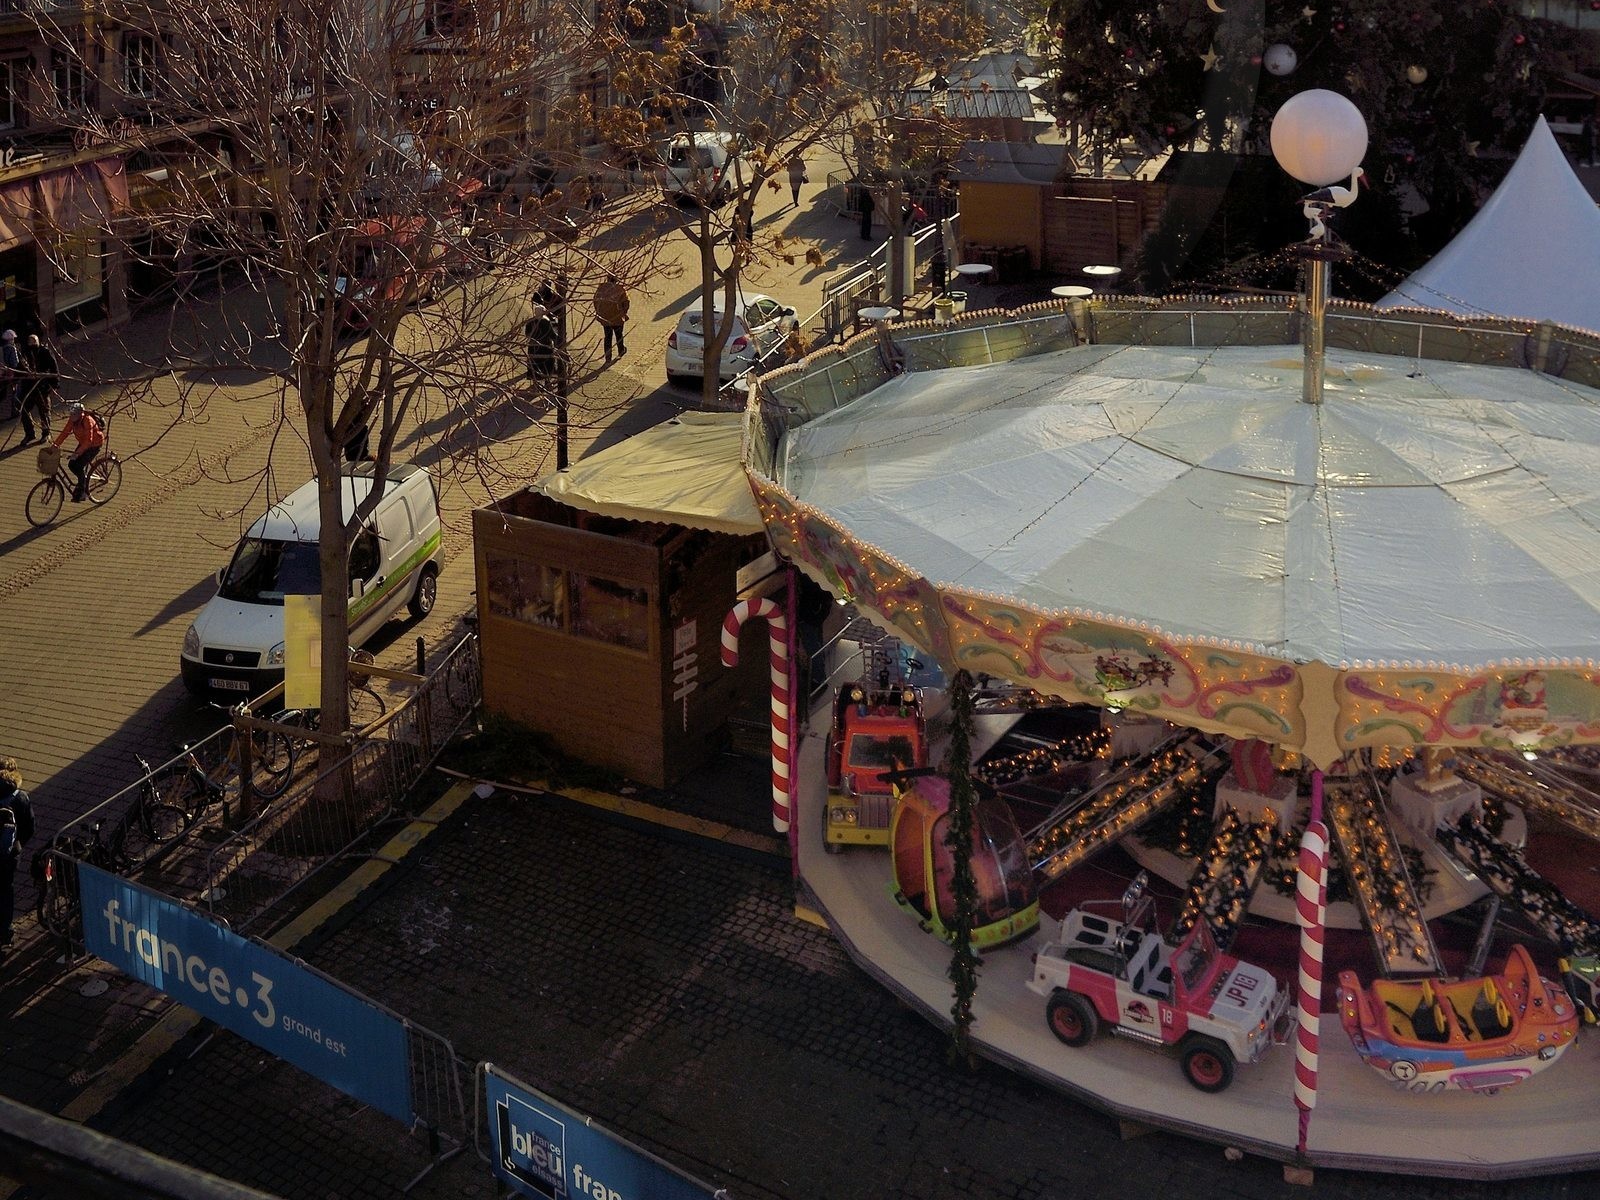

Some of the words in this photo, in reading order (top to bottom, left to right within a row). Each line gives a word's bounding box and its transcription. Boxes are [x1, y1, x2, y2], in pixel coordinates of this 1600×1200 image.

[1225, 987, 1249, 1008] JP
[1162, 1008, 1173, 1025] 18
[282, 1014, 322, 1044] grand
[325, 1037, 347, 1057] est
[511, 1124, 562, 1178] bleu
[531, 1131, 561, 1156] france
